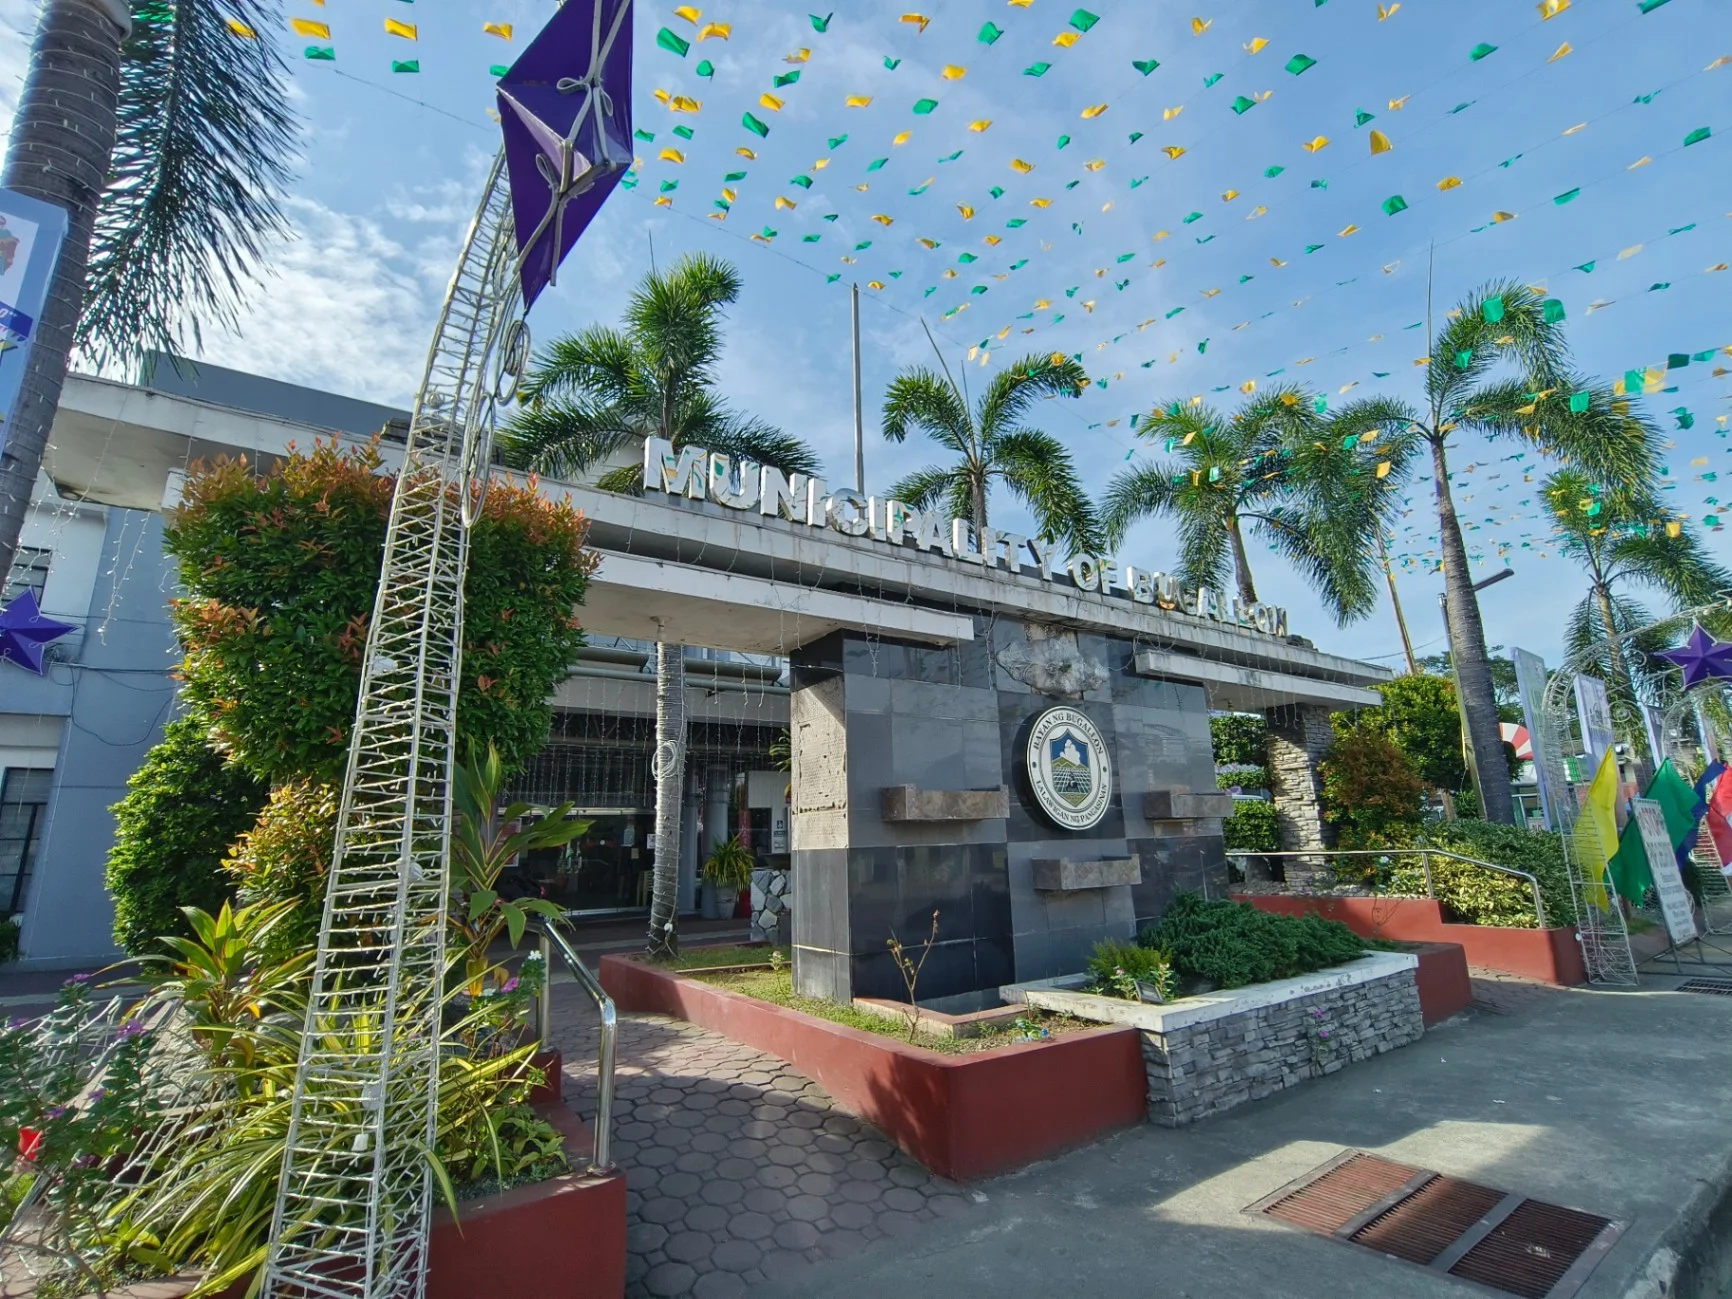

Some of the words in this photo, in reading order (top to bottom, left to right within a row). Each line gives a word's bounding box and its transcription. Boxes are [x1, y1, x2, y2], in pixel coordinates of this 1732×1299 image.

[643, 436, 1056, 581] MUNICIPALITY
[1067, 551, 1118, 595] OF
[1126, 565, 1289, 638] BUGALLON
[1033, 717, 1053, 750] BAYAN
[1052, 713, 1064, 723] NG
[1066, 712, 1104, 755] BUGALLON
[1036, 780, 1070, 820] LALAWIGAN
[1080, 782, 1108, 823] PANGASINAN
